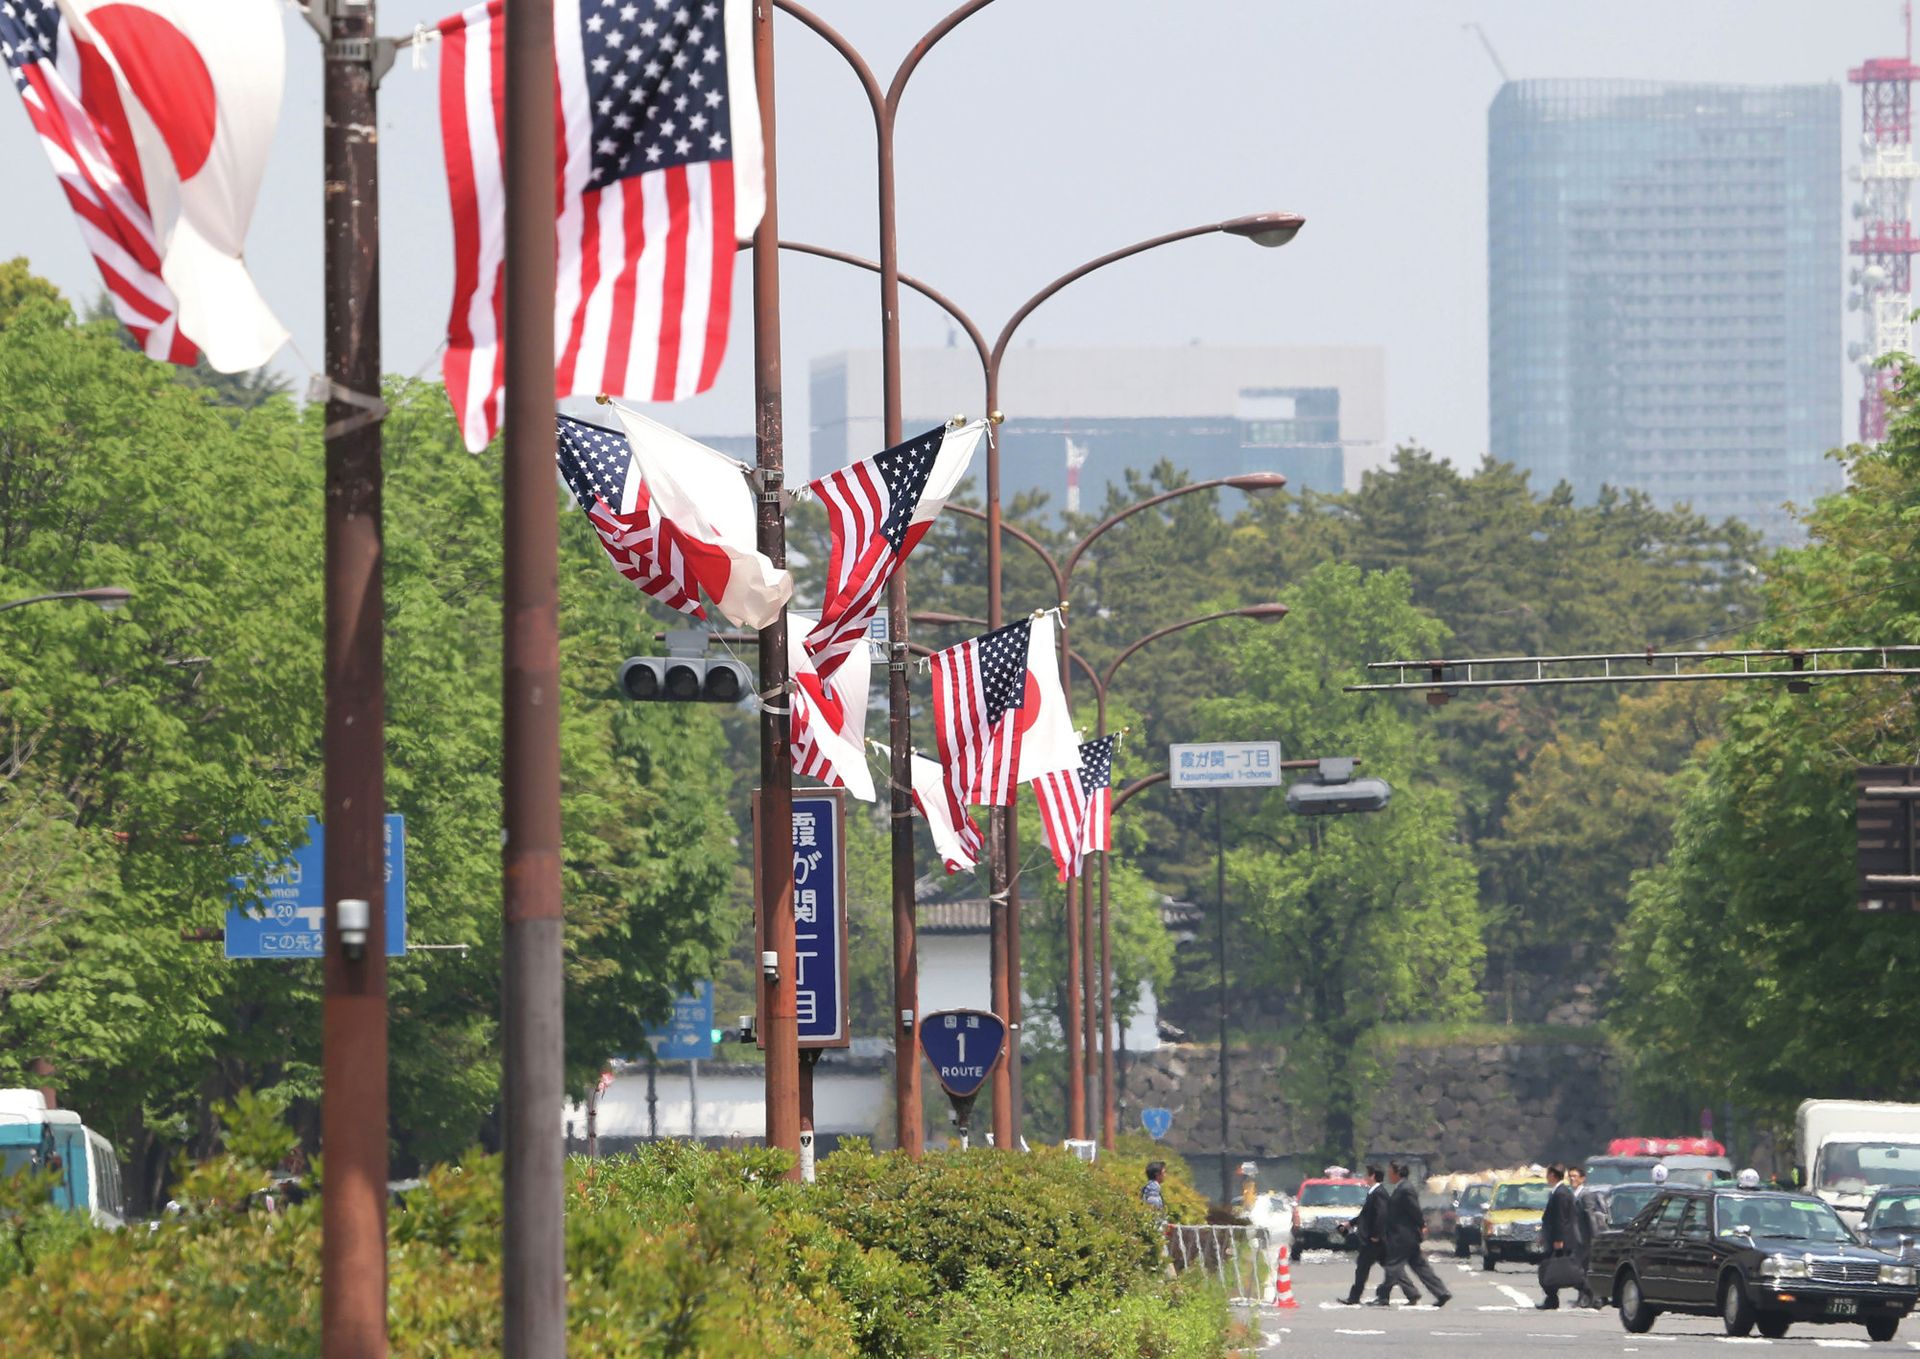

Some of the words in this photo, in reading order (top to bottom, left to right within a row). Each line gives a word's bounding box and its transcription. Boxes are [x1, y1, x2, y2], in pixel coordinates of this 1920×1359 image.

[1180, 749, 1270, 769] 霞が関一丁目
[1180, 770, 1233, 782] Kasumigaseki
[278, 905, 293, 918] 20
[944, 1014, 979, 1029] 国道
[956, 1033, 966, 1063] 1
[941, 1066, 983, 1077] ROUTE
